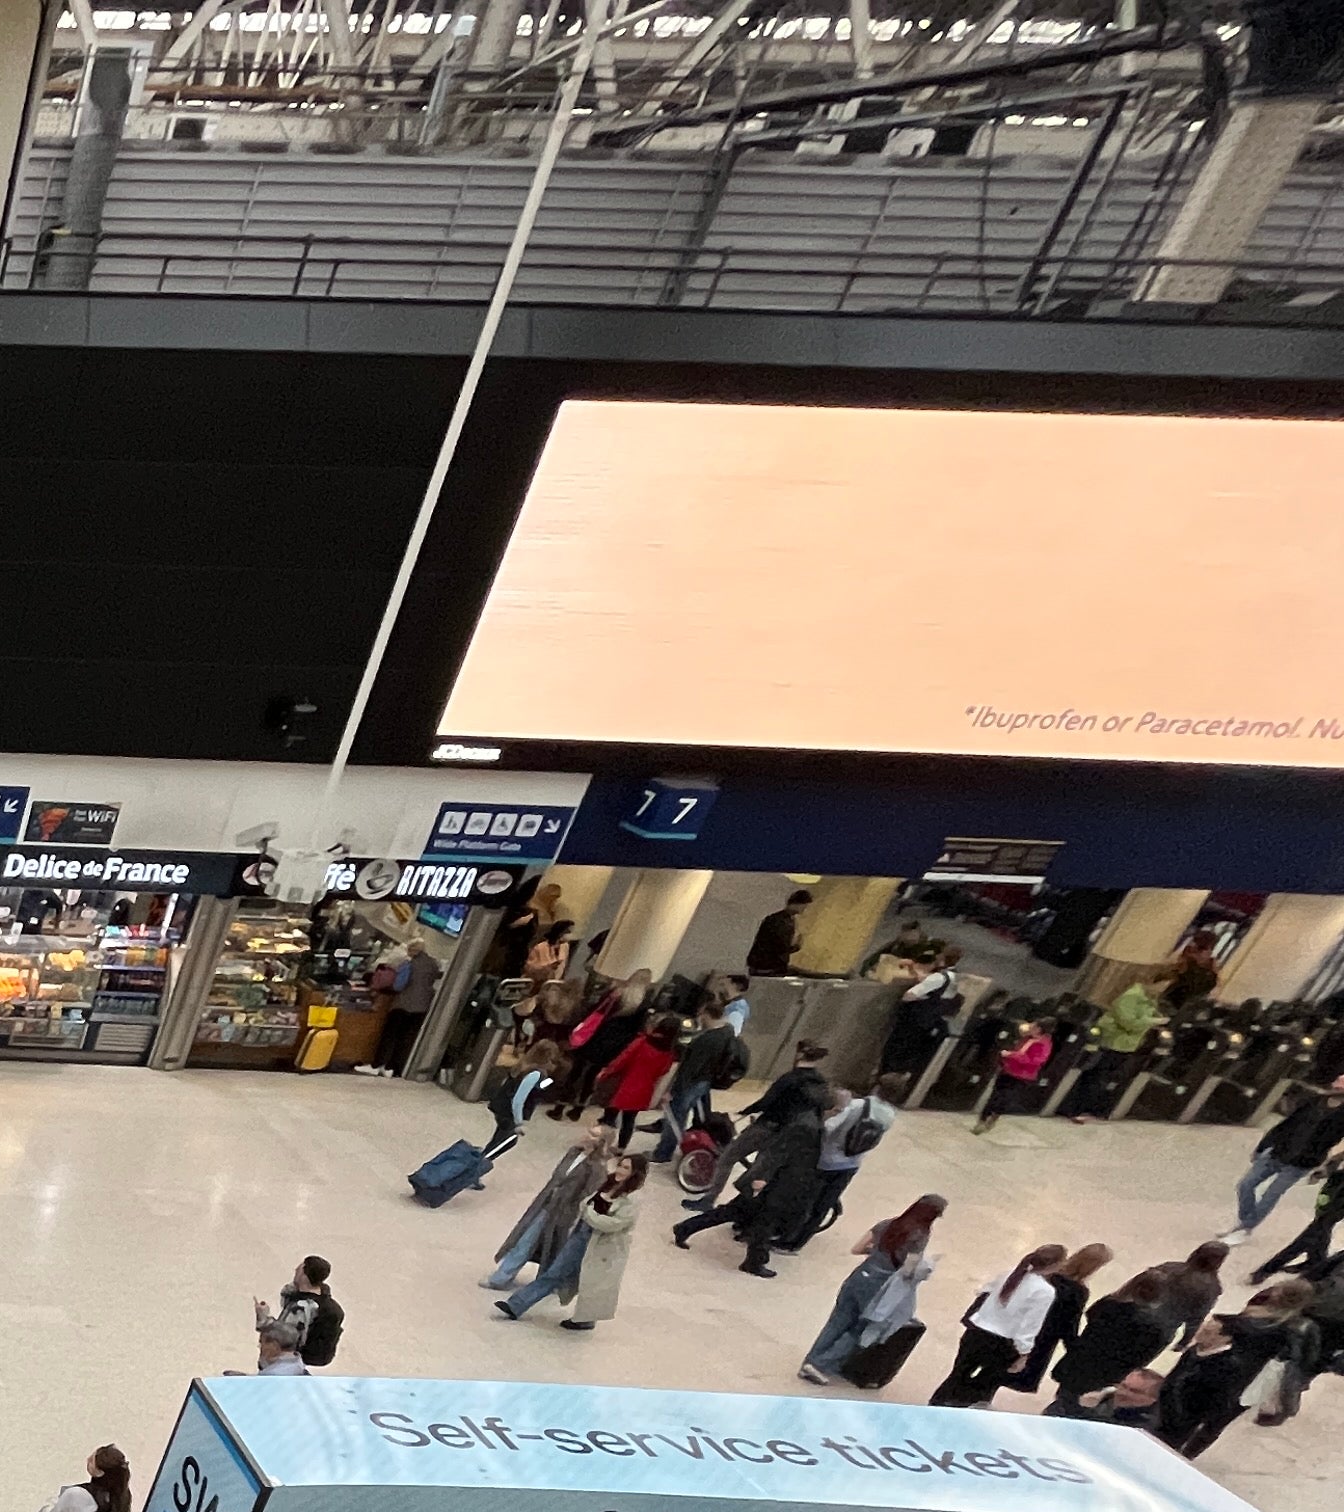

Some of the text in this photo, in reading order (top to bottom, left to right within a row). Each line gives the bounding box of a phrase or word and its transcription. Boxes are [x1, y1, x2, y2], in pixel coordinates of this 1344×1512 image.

[1102, 715, 1133, 732] or
[1134, 711, 1304, 739] Paracetamol.
[85, 809, 118, 824] WiFi
[636, 789, 656, 816] 7
[671, 798, 698, 824] 7
[3, 853, 190, 884] Delice de France
[395, 864, 479, 898] RITAZZA
[369, 1409, 1096, 1486] Self-service tickets
